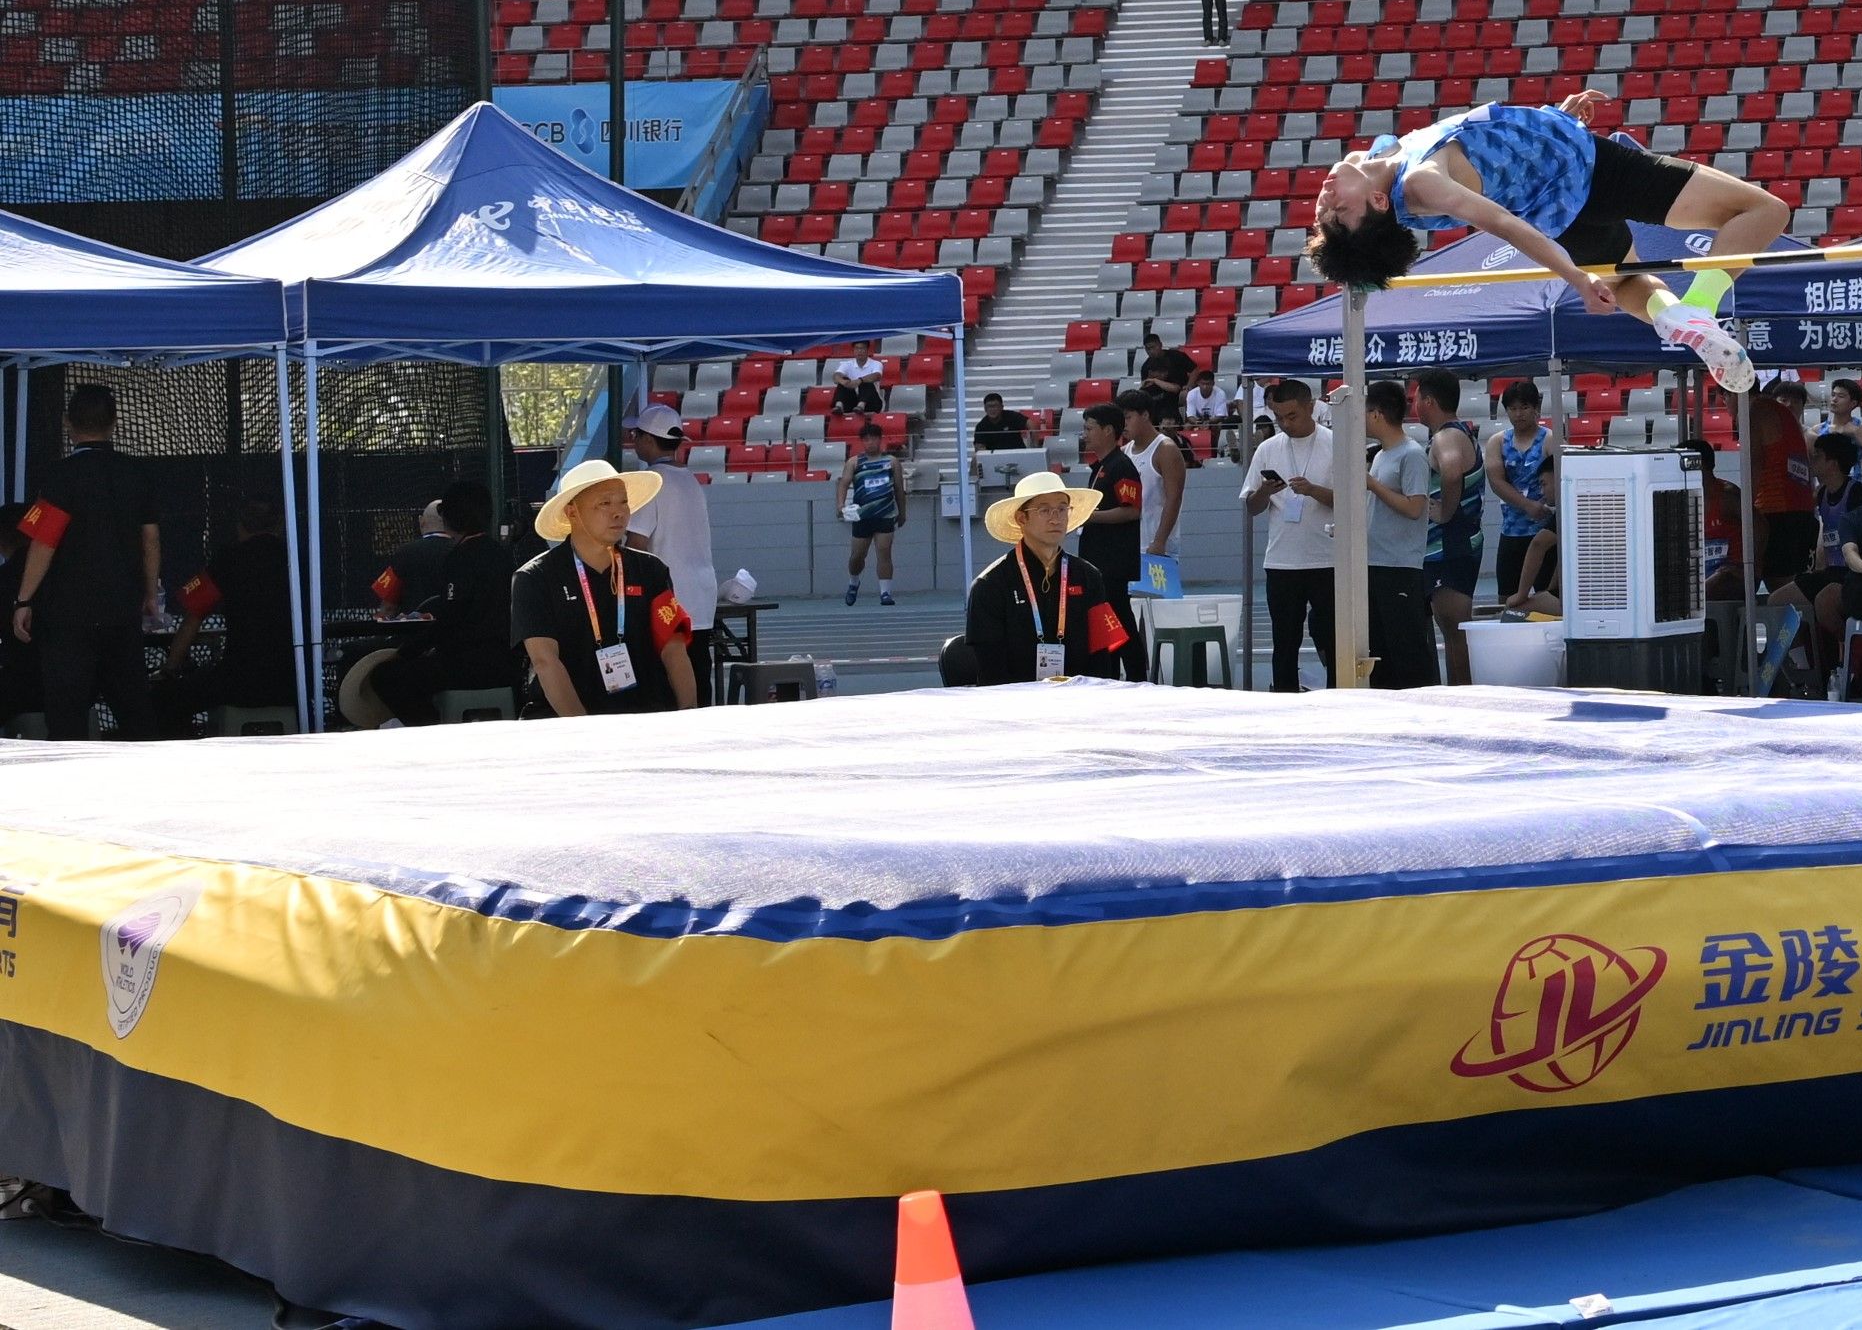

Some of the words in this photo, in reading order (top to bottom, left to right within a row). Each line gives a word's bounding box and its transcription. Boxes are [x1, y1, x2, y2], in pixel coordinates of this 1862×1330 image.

[1308, 331, 1387, 366] 相信众
[1396, 328, 1479, 364] 我选移动
[1686, 1007, 1842, 1051] JINLING
